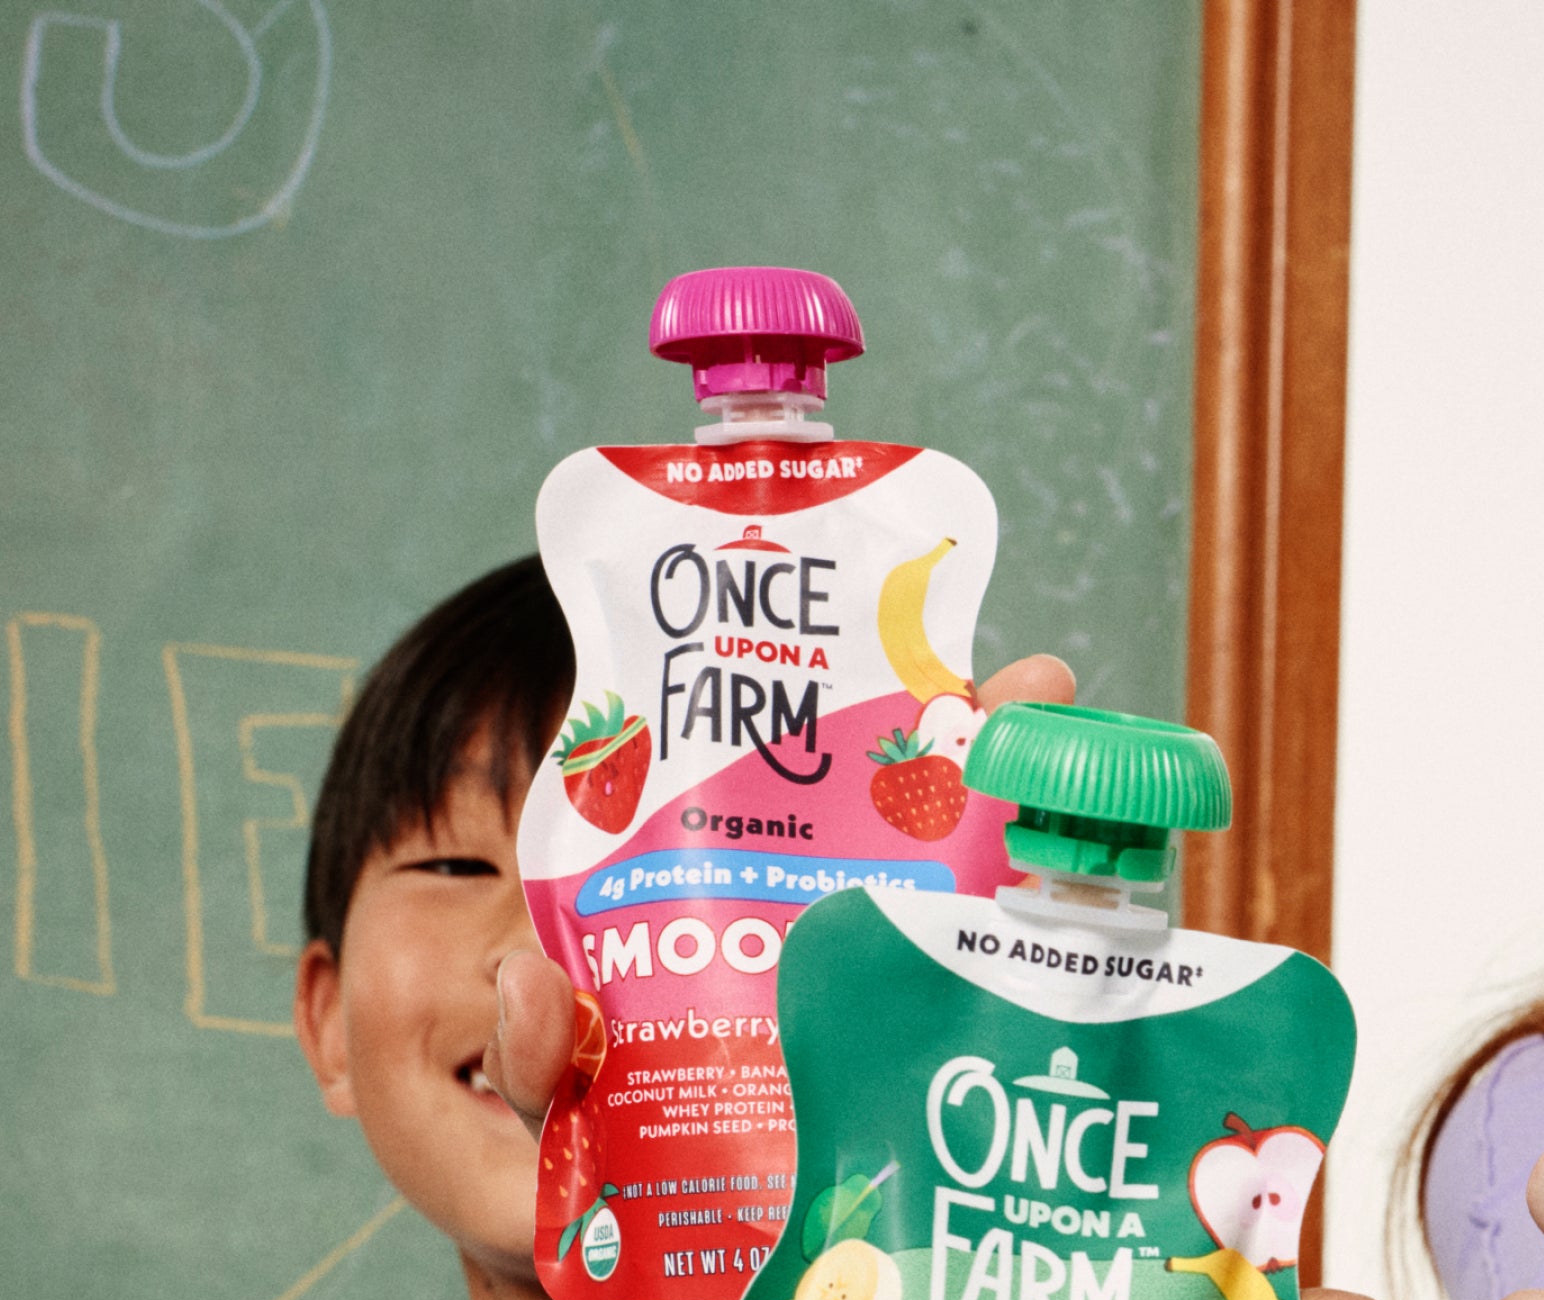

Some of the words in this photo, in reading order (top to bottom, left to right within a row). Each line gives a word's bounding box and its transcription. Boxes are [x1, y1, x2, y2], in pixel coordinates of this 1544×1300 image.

[666, 461, 702, 483] NO
[708, 459, 774, 482] ADDED
[651, 543, 840, 639] ONCE
[714, 636, 801, 667] UPON
[808, 647, 830, 670] A
[659, 642, 833, 785] FARM
[680, 807, 814, 840] Organic
[599, 876, 625, 900] 4g
[630, 861, 732, 891] Protein
[740, 867, 758, 884] +
[582, 917, 795, 992] SMOO
[957, 929, 1000, 955] NO
[1008, 939, 1099, 976] ADDED
[611, 1008, 779, 1047] Strawberry
[627, 1066, 724, 1086] STRAWBERRY
[607, 1087, 674, 1107] COCONUT
[679, 1085, 717, 1100] MILK
[662, 1104, 710, 1118] WHEY
[715, 1101, 785, 1116] PROTEIN
[640, 1122, 708, 1139] PUMPKIN
[713, 1120, 752, 1134] SEED
[926, 1055, 1160, 1200] ONCE
[655, 1181, 677, 1196] LOW
[681, 1177, 726, 1194] CALORIE
[767, 1174, 786, 1189] SEE
[658, 1209, 723, 1228] PERISHABLE
[737, 1207, 764, 1223] KEEP
[1003, 1195, 1110, 1238] UPON
[1118, 1212, 1146, 1239] A
[663, 1251, 694, 1278] NET
[700, 1249, 726, 1275] WT
[733, 1248, 744, 1272] 4
